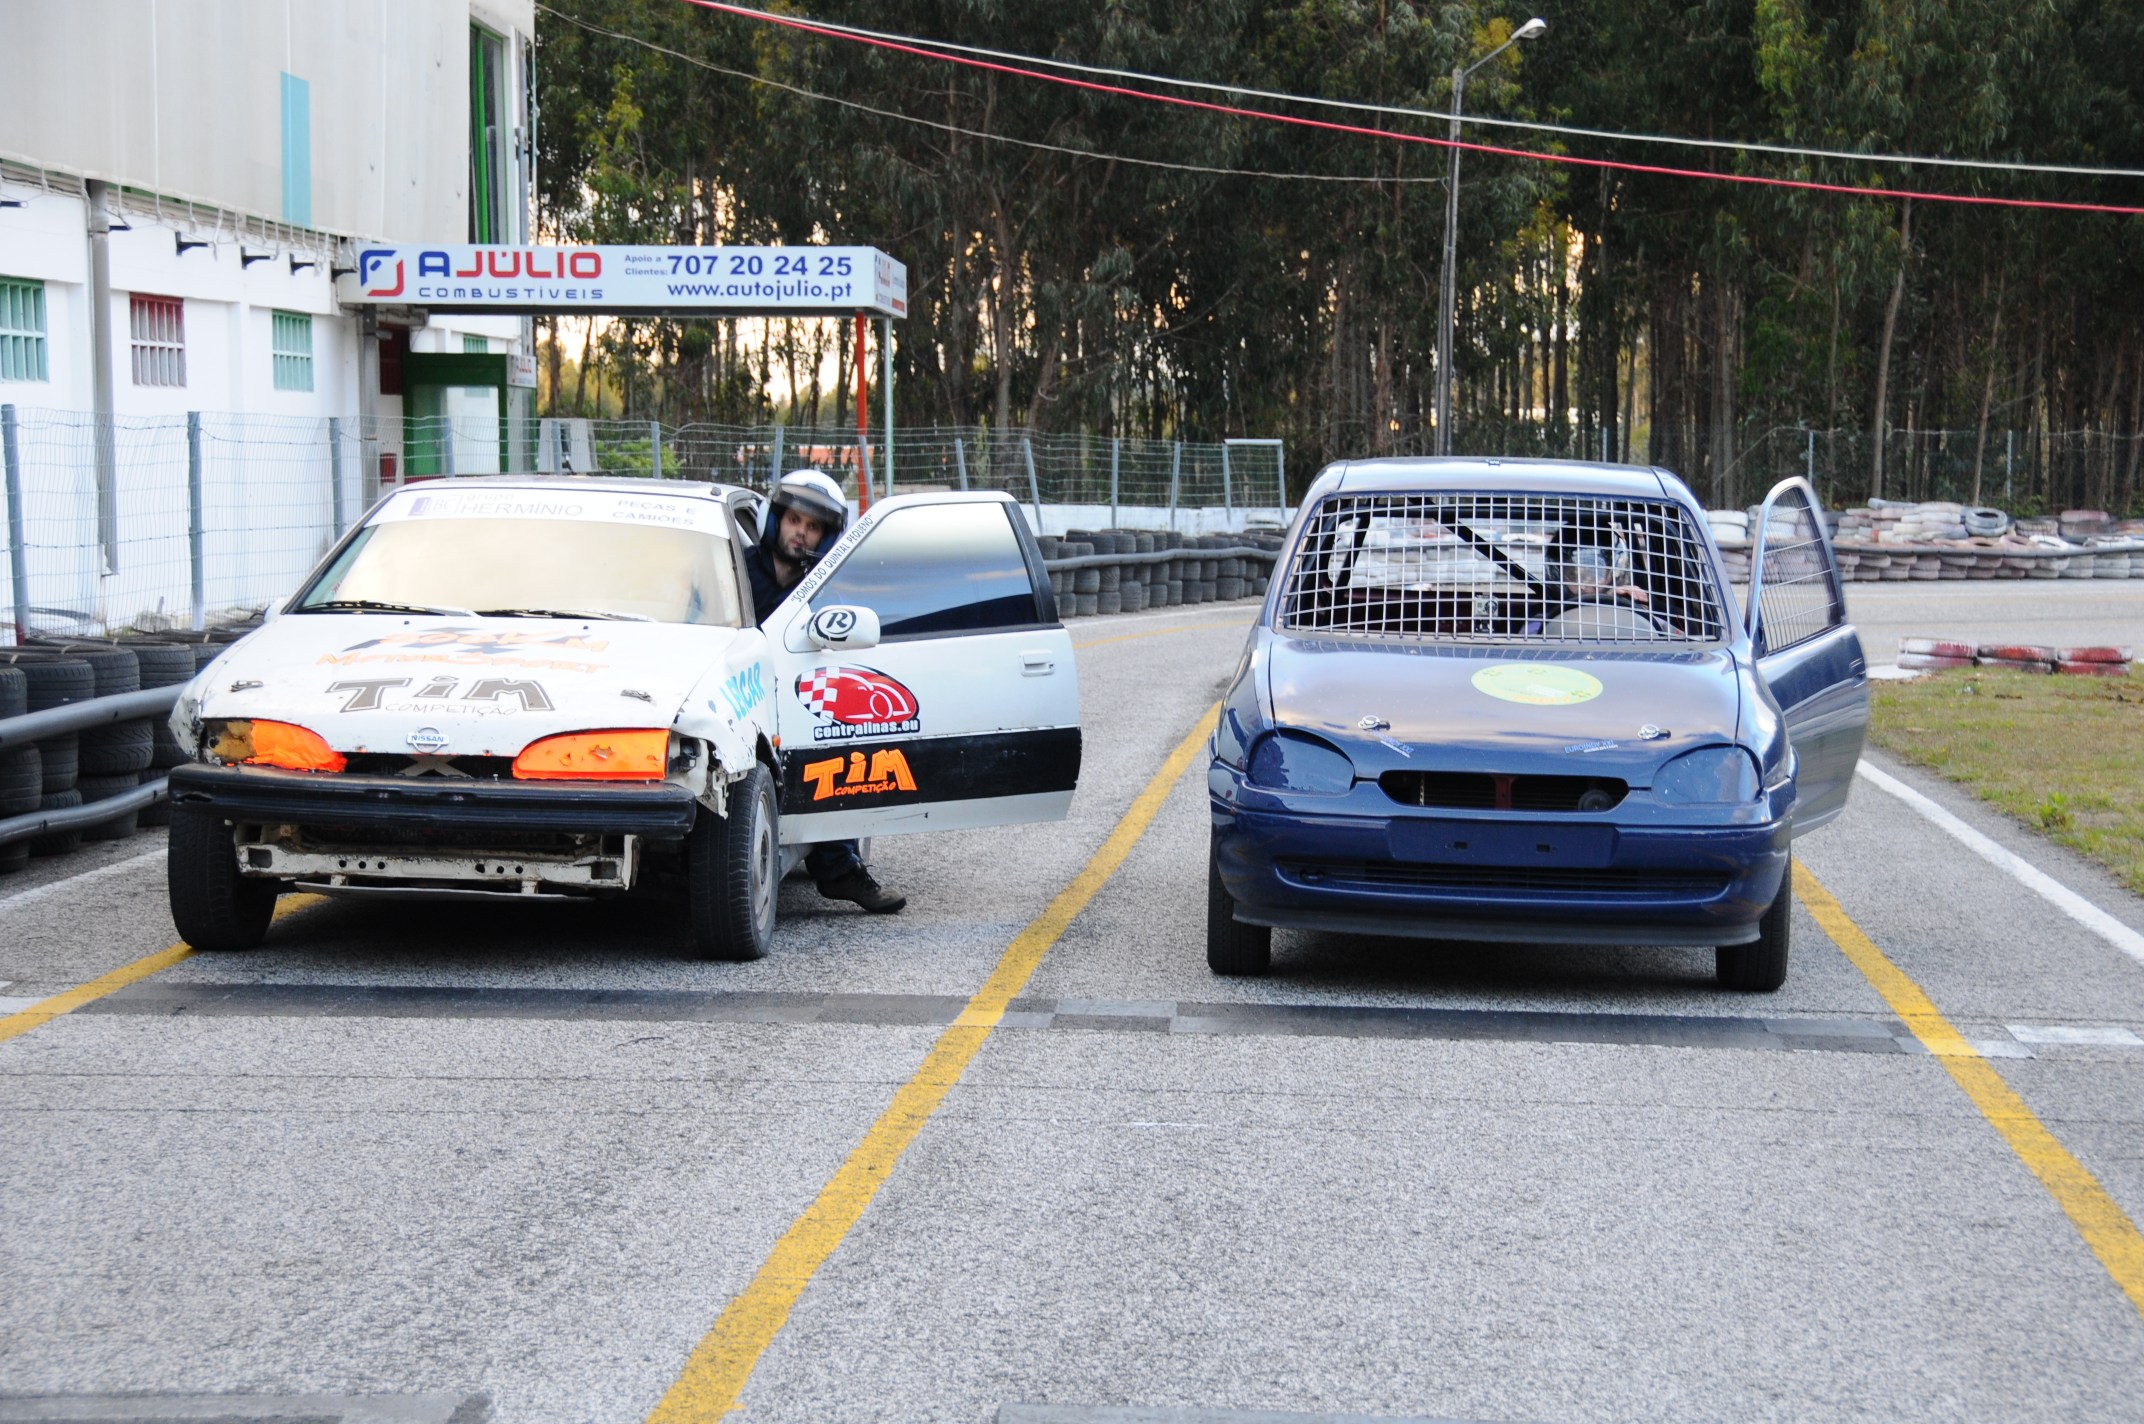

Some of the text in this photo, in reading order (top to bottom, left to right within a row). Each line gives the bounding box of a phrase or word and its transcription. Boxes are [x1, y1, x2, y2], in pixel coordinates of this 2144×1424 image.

[624, 254, 654, 264] Apoio
[667, 255, 719, 276] 707
[729, 255, 764, 276] 20
[774, 256, 808, 276] 24
[818, 256, 852, 277] 25
[624, 267, 668, 277] Clientes:
[418, 285, 604, 300] COMBUSTÍVEIS
[667, 280, 852, 302] www.autojulio.pt
[460, 500, 584, 517] HERMÍNIO
[617, 500, 676, 511] PEÇAS
[612, 511, 694, 525] CAMIÕES
[813, 567, 827, 580] DO
[824, 542, 851, 569] QUINTAL
[826, 612, 848, 629] R
[384, 702, 519, 717] COMPETIÇÃO
[814, 719, 919, 739] centralinas.eu
[411, 735, 444, 743] NISSAN
[834, 780, 897, 796] COMPETIÇÃO
